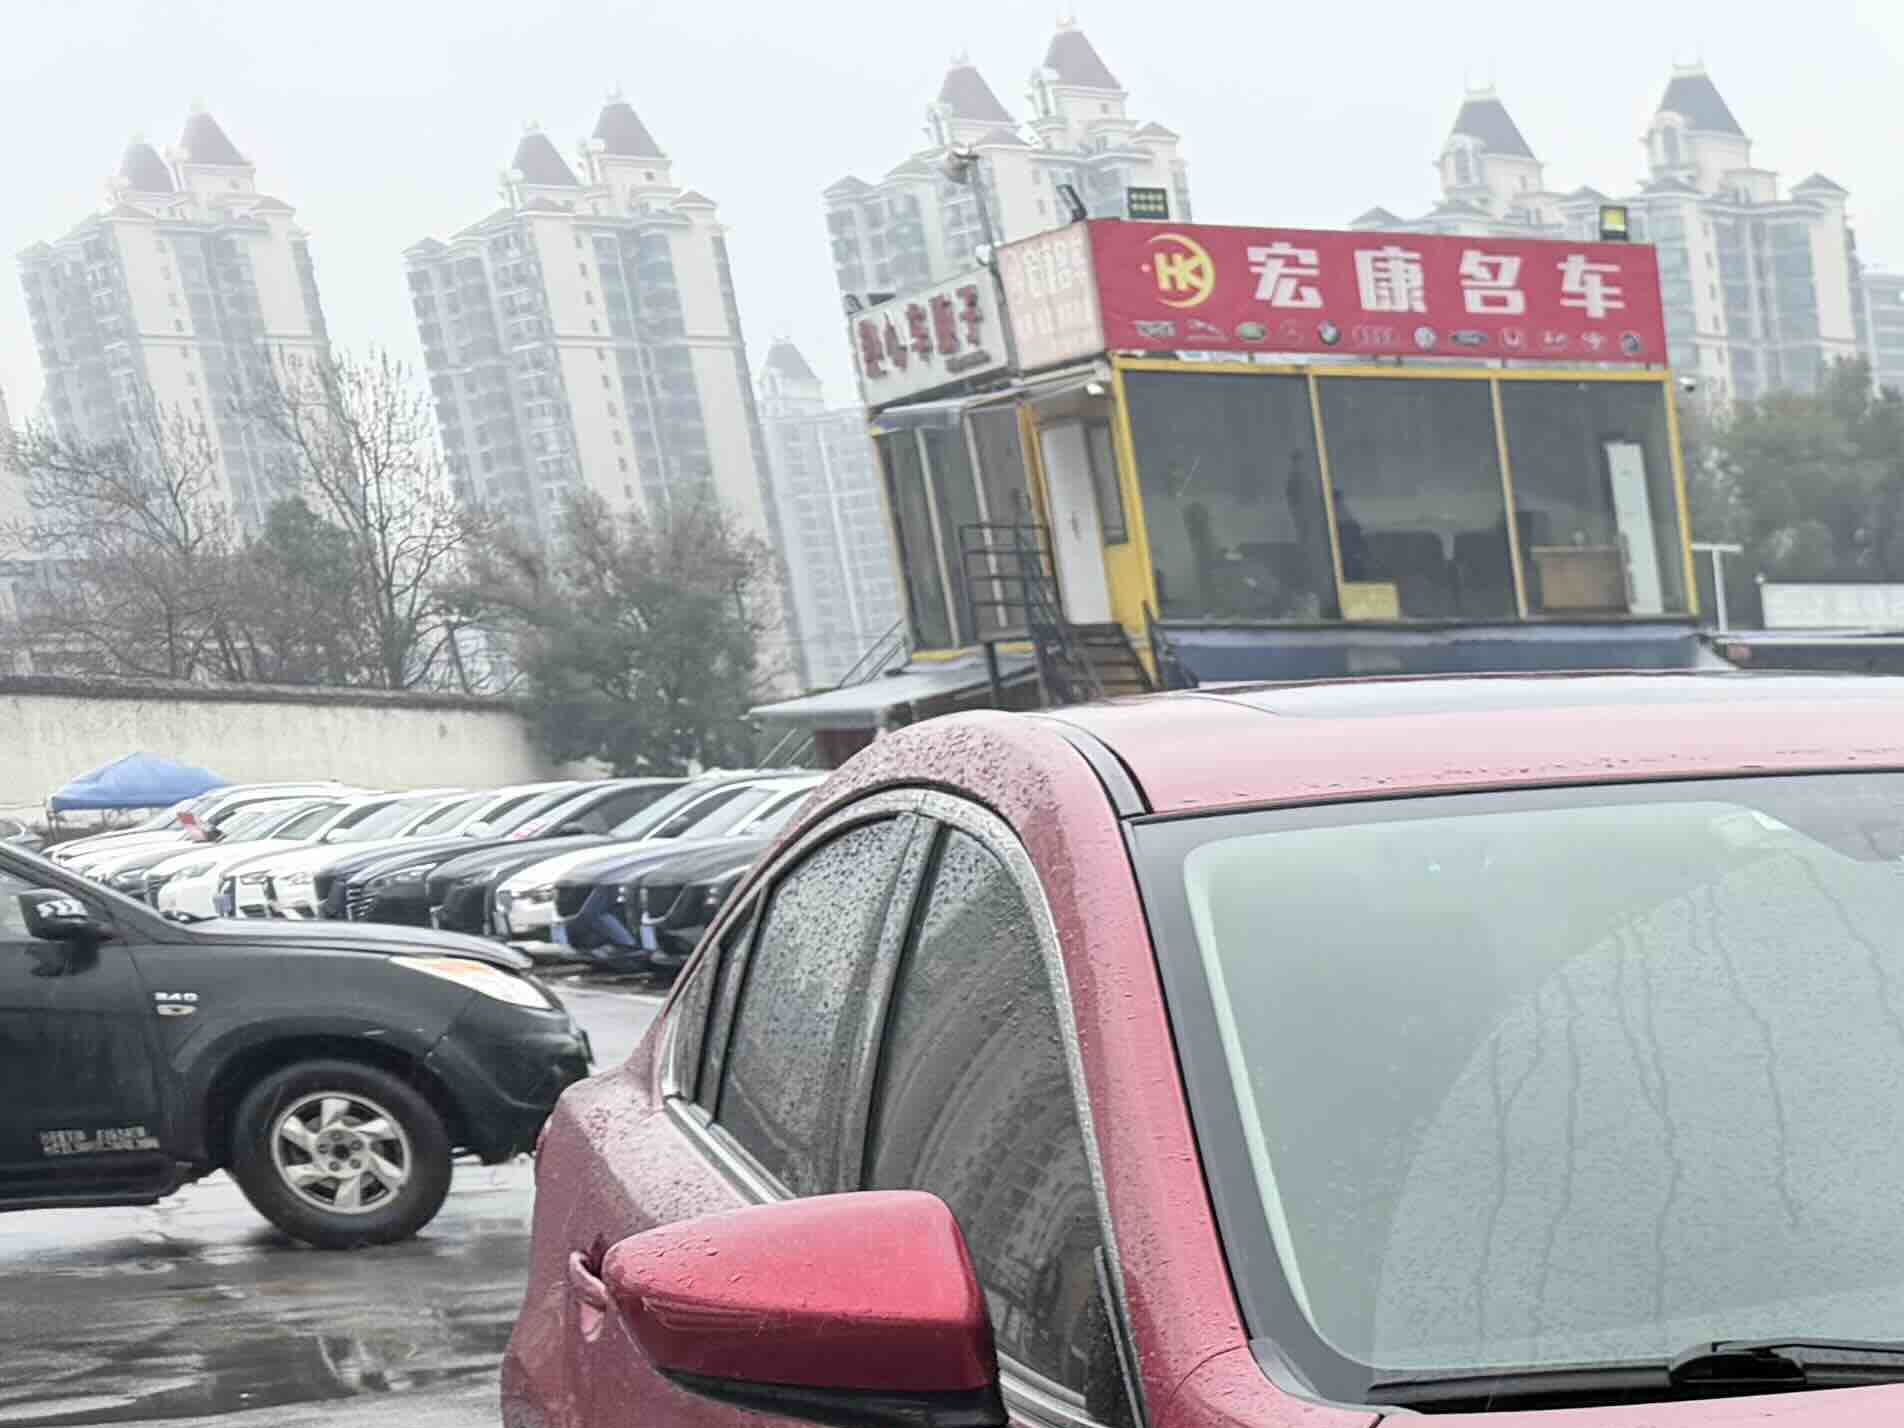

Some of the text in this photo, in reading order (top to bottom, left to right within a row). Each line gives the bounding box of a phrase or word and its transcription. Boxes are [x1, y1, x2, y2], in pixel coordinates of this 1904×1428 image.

[1153, 252, 1204, 293] HK
[1246, 241, 1625, 319] 宏康名车
